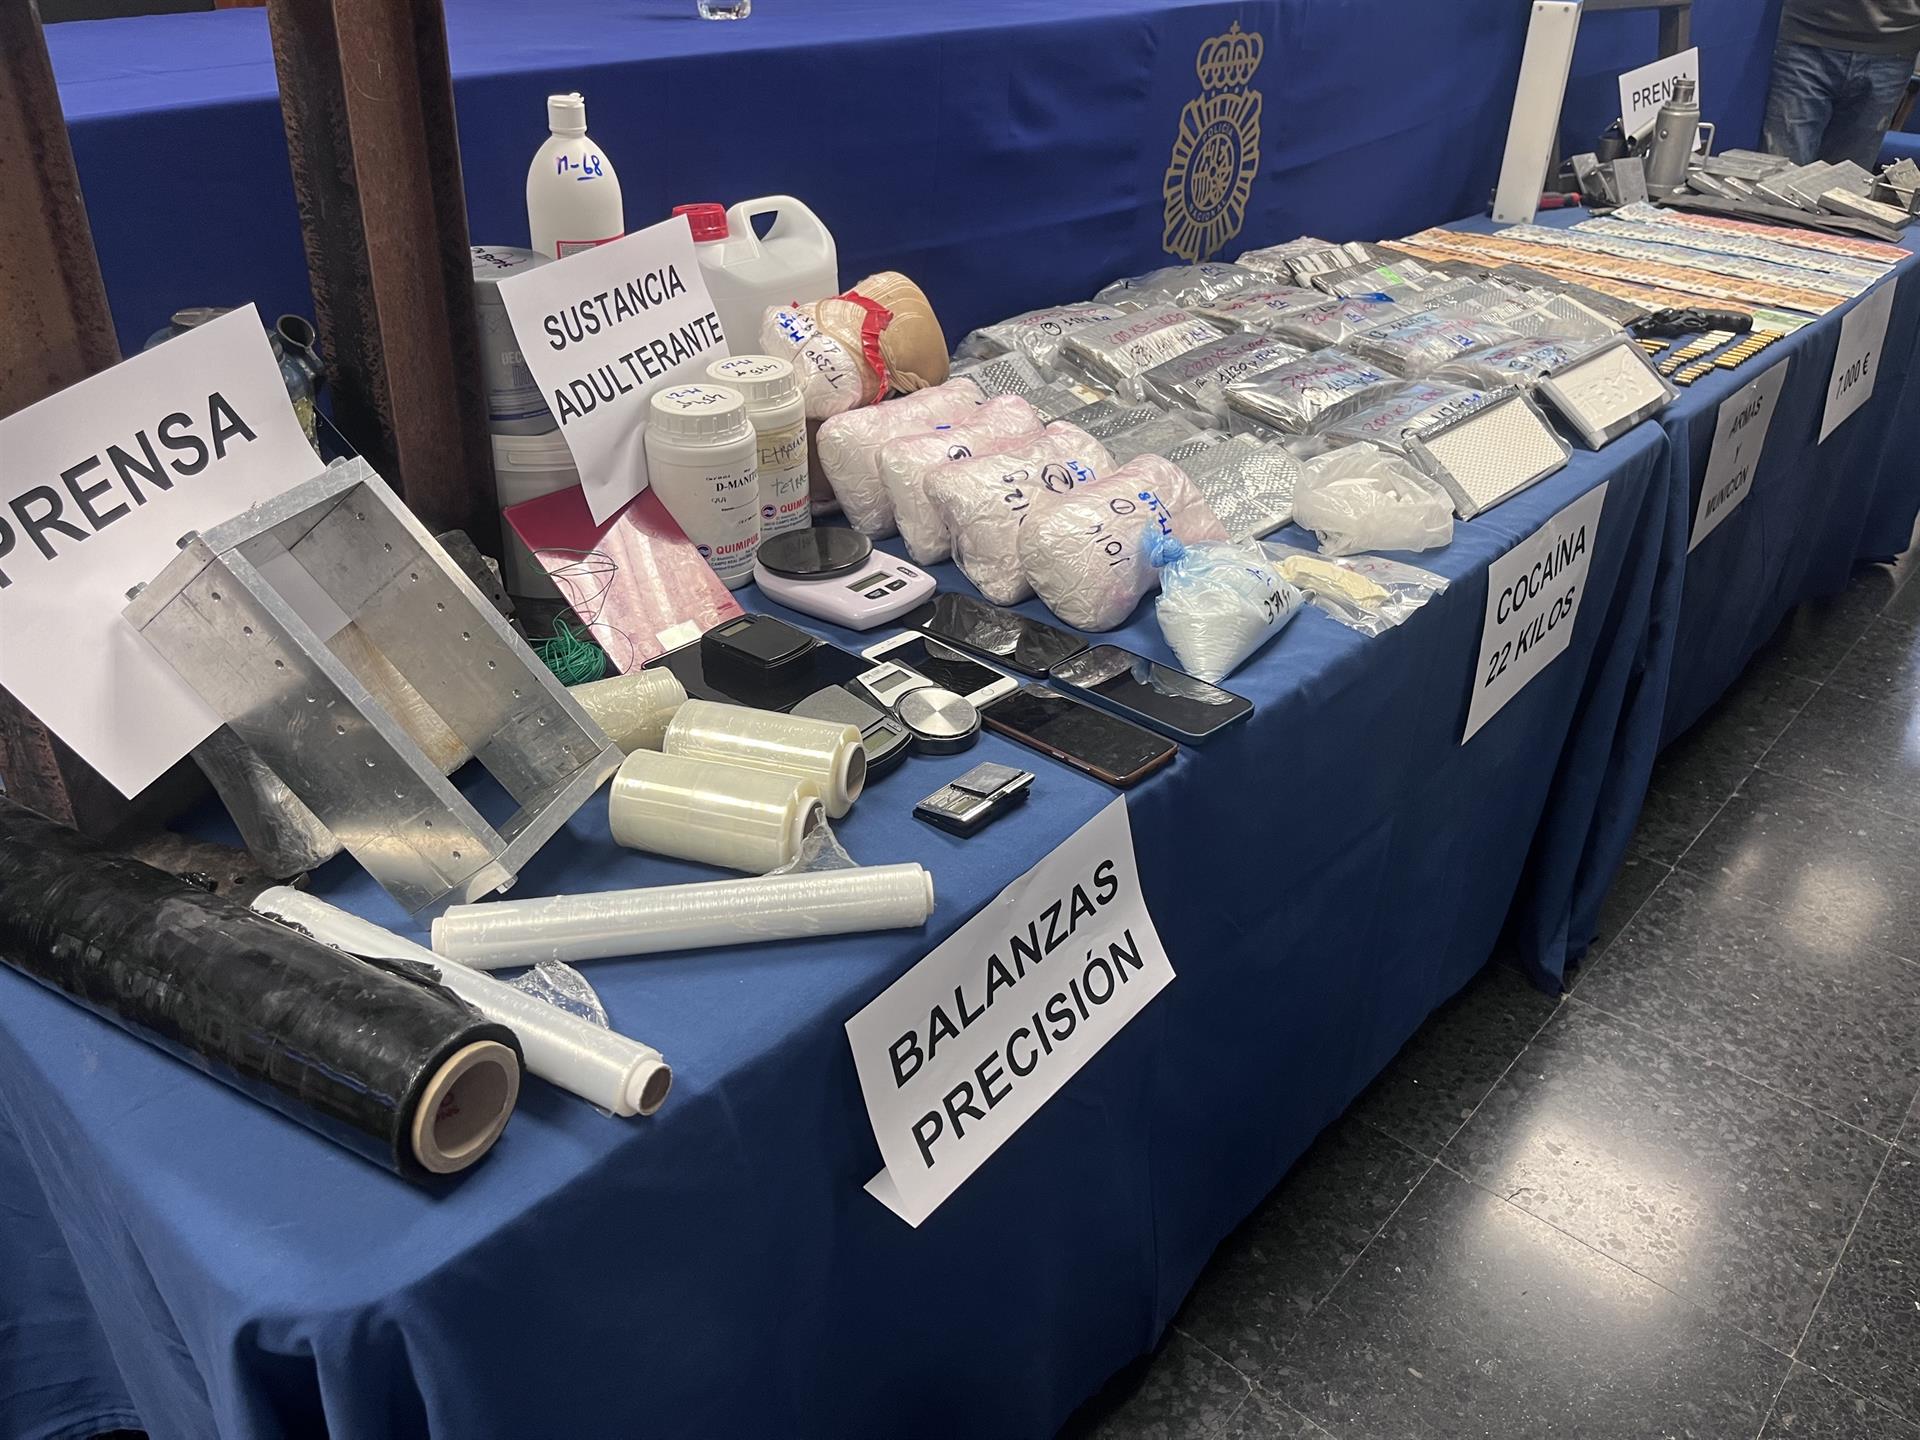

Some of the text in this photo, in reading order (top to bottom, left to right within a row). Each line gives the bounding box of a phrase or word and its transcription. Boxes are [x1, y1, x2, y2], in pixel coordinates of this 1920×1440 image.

[543, 264, 686, 351] SUSTANCIA
[553, 311, 725, 427] ADULTERANTE
[1862, 352, 1871, 375] €
[1728, 395, 1763, 438] ARMAS
[1497, 525, 1585, 625] COCAÍNA
[1485, 586, 1576, 688] 22 KILOS
[888, 859, 1119, 1089] BALANZAS
[911, 929, 1145, 1169] PRECISIÓN
